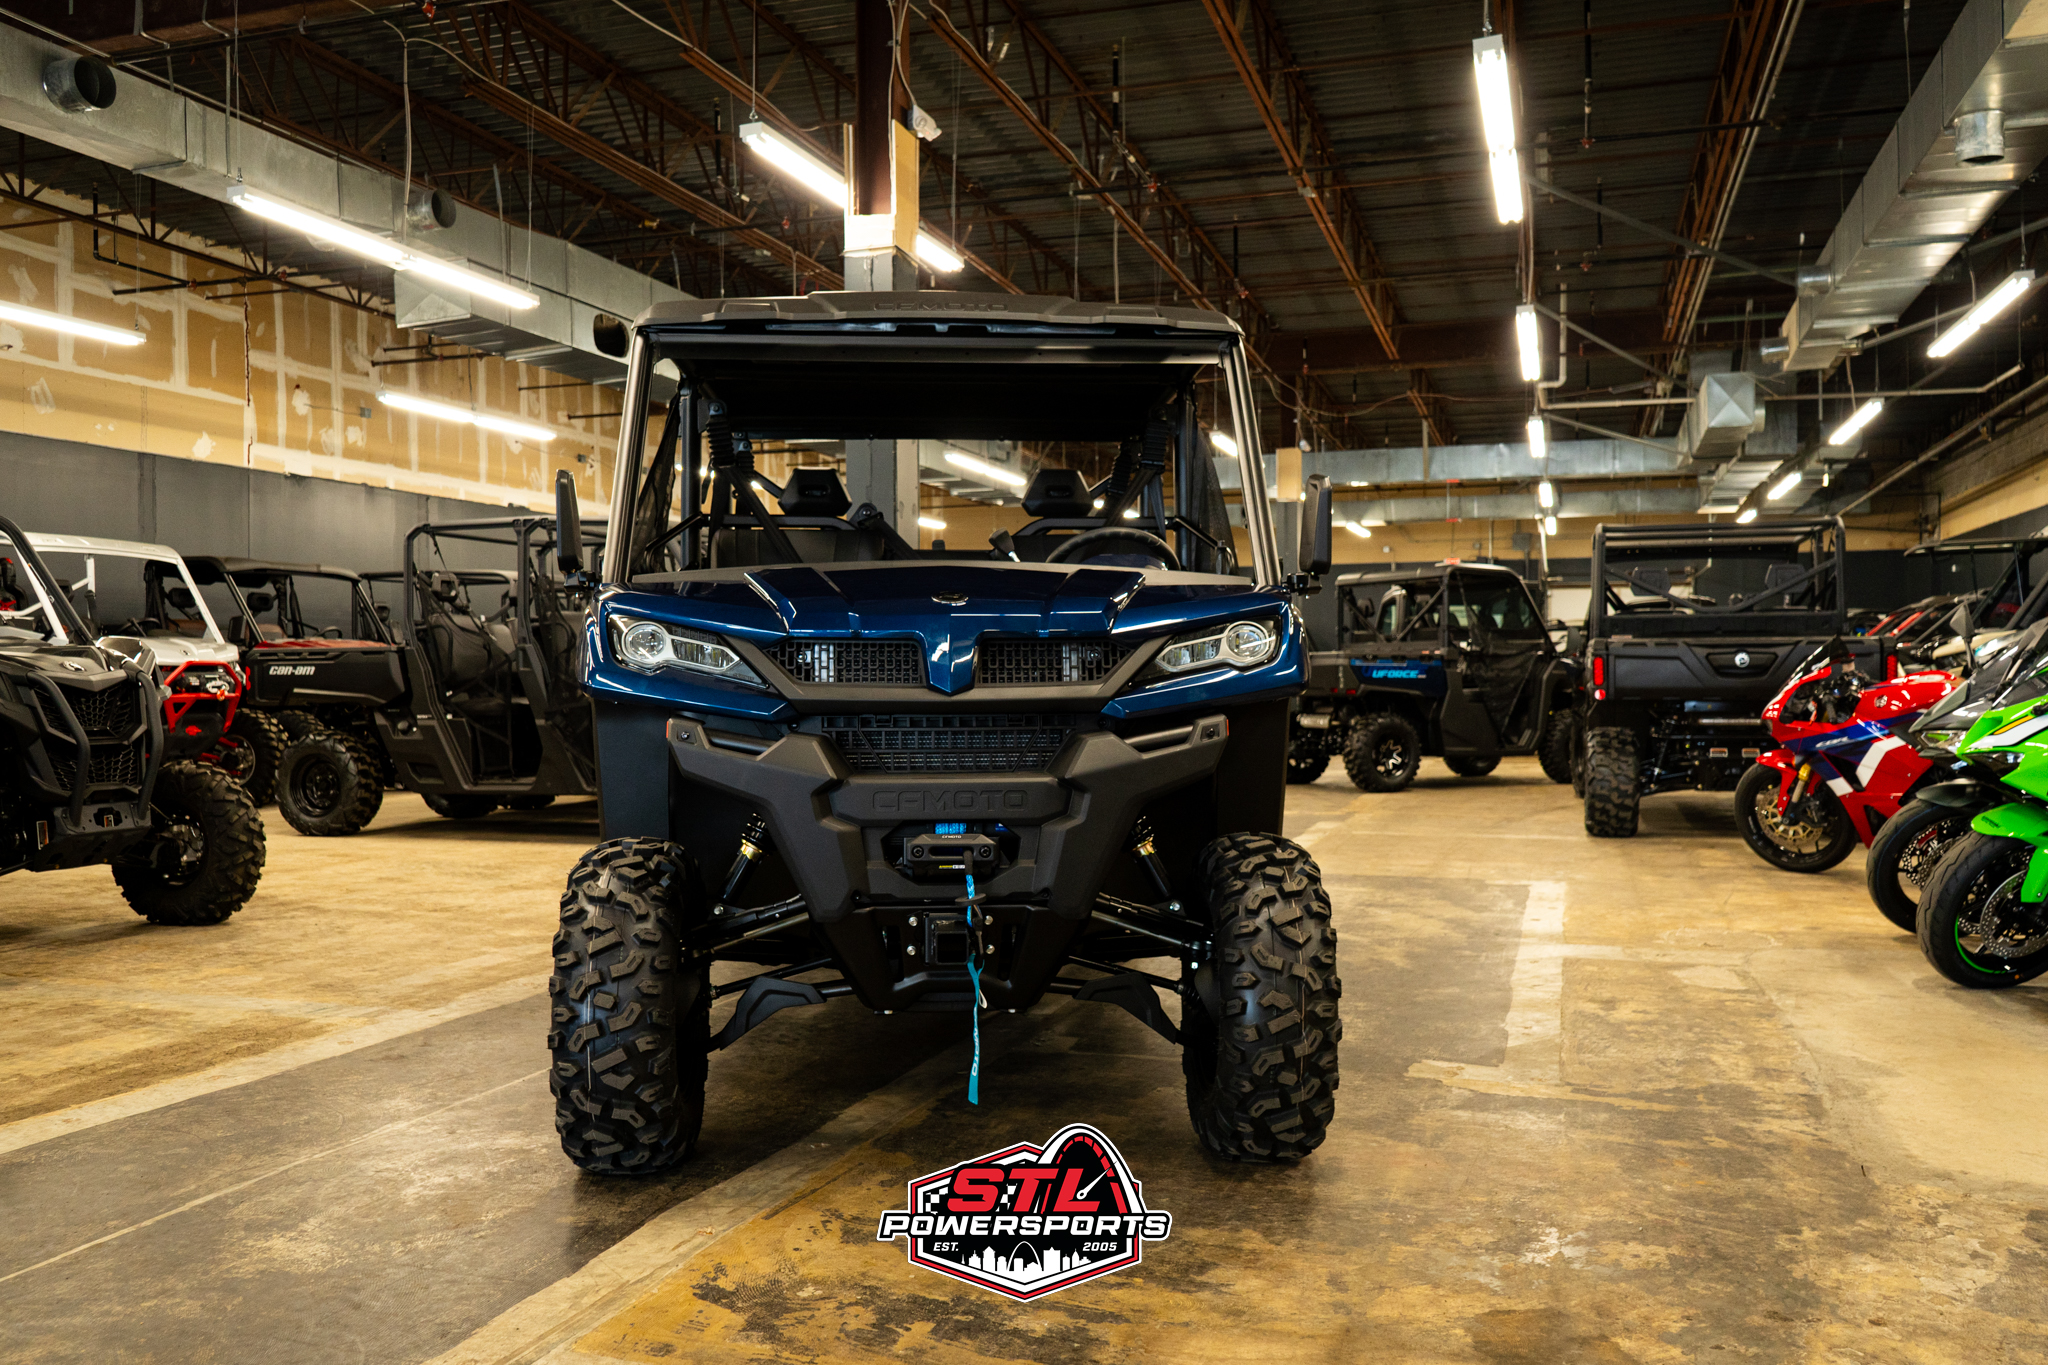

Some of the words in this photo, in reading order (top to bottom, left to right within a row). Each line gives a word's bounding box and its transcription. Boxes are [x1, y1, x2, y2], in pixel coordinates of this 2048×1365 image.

[269, 665, 315, 676] can-am
[1372, 669, 1419, 678] UFORCE
[873, 790, 1028, 812] CFMOTO
